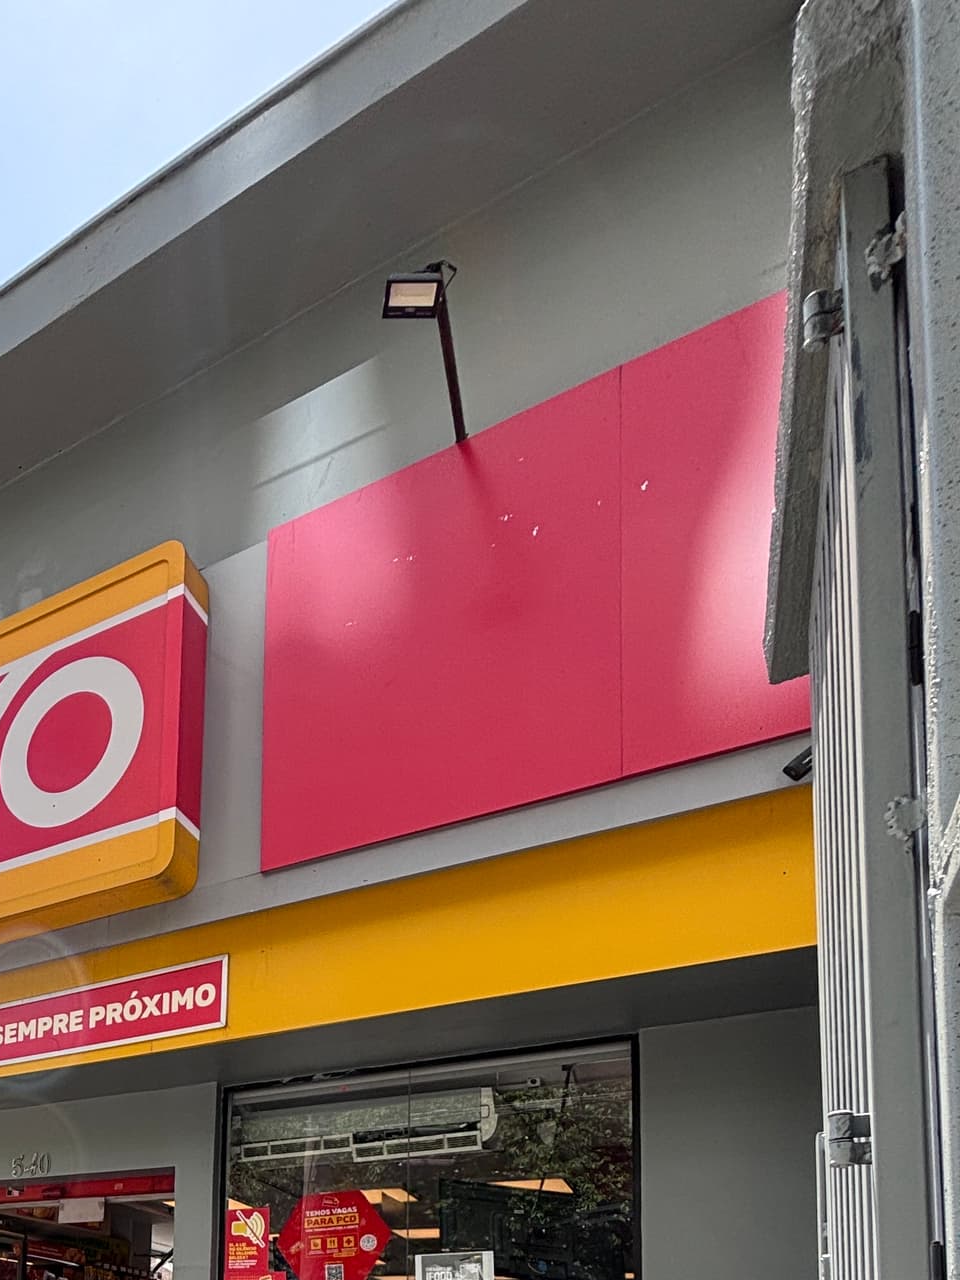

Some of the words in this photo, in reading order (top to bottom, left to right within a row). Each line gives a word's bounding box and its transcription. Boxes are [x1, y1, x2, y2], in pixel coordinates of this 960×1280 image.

[89, 982, 217, 1029] PRÓXIMO
[11, 1152, 51, 1178] 540
[331, 1206, 358, 1215] VAGAS
[306, 1217, 335, 1227] PARA
[336, 1215, 357, 1225] PCD
